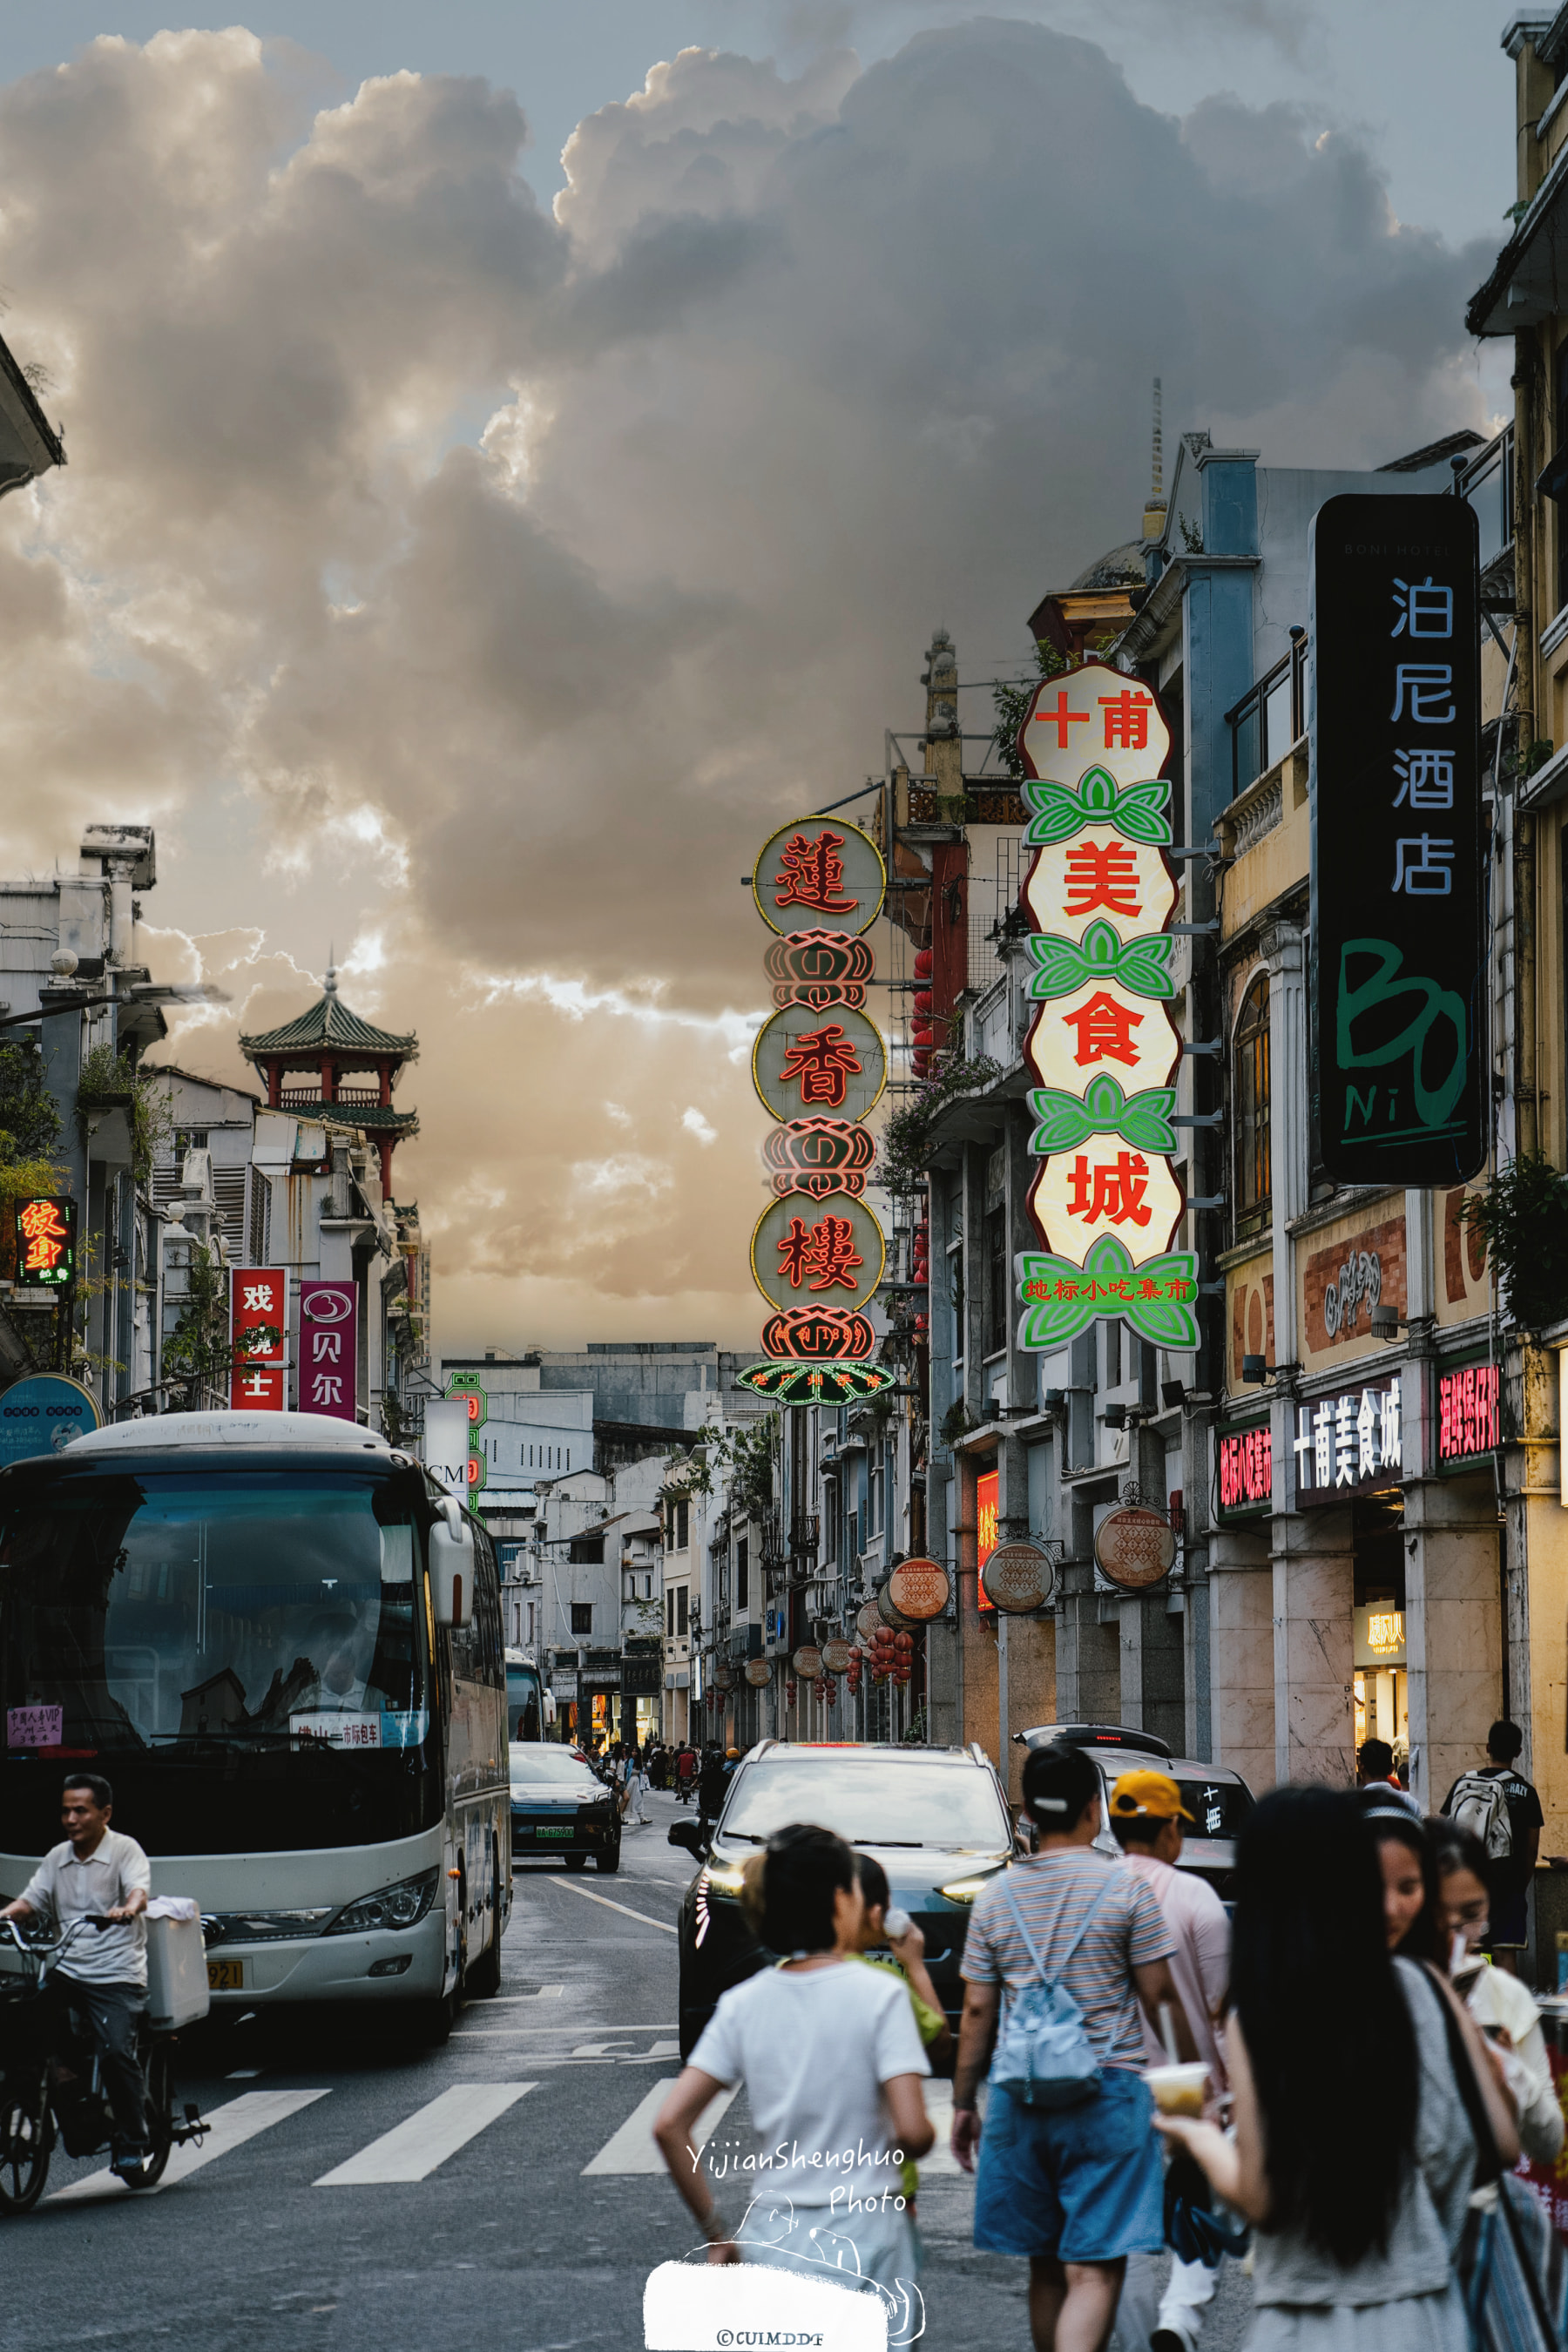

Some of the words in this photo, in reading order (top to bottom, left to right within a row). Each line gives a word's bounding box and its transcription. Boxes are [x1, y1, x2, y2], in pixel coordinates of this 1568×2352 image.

[1344, 544, 1388, 556] BONI
[1396, 544, 1450, 558] HOTEL
[1035, 689, 1154, 751] 十甫
[1391, 576, 1456, 896] 泊尼酒店
[775, 830, 864, 1292] 蓮香樓
[1061, 841, 1153, 1227] 美食城
[1025, 1278, 1192, 1301] 地标小吃集市
[311, 1332, 342, 1406] 贝尔
[1220, 1428, 1271, 1507] 地标小吃集市
[1294, 1378, 1402, 1490] 十甫美食城
[1504, 1781, 1528, 1797] CRAZY
